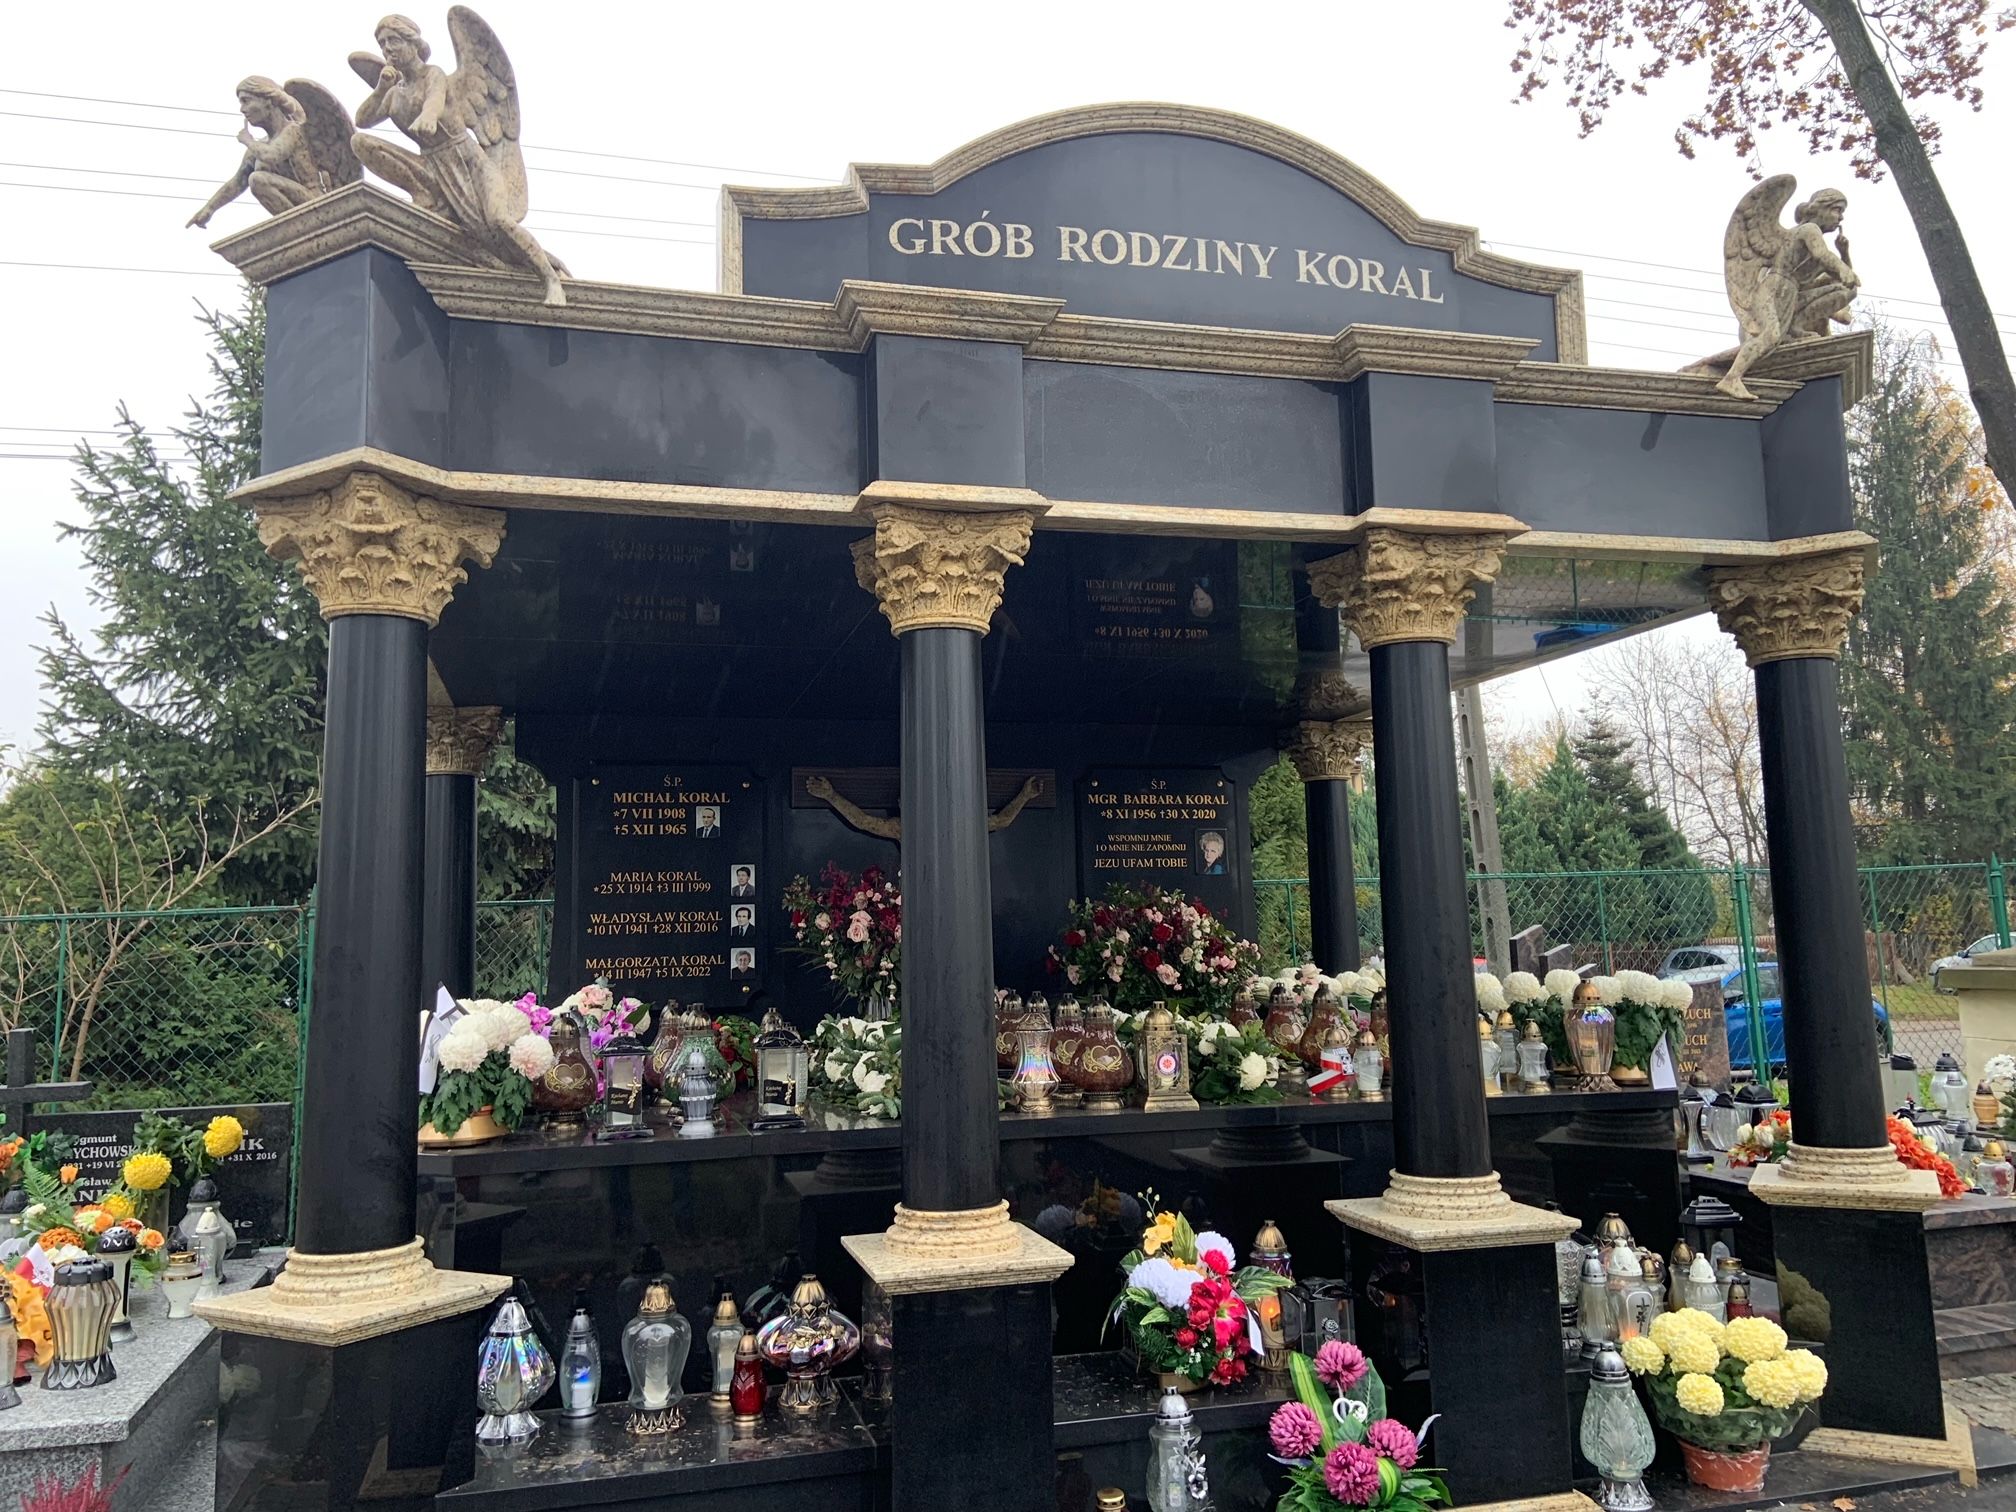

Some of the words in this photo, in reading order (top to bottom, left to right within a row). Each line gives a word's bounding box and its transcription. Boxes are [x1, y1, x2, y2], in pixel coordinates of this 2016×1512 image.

[889, 210, 1034, 258] GRÓB
[1057, 226, 1278, 279] RODZINY
[1295, 248, 1444, 304] KORAL
[679, 792, 731, 804] KORAL
[1088, 793, 1117, 805] MGR
[1124, 793, 1183, 805] BARBARA
[1186, 793, 1229, 805] KORAL
[632, 808, 653, 819] VII
[658, 808, 686, 819] 1908
[1116, 808, 1129, 819] XI
[1133, 808, 1157, 819] 1956
[1181, 808, 1190, 819] X
[1192, 808, 1217, 819] 2020
[633, 824, 654, 836] XII
[659, 823, 687, 835] 1965
[1107, 834, 1149, 843] WSPOMNIJ
[1151, 834, 1172, 842] MNIE
[1108, 844, 1130, 852] MNIE
[1146, 843, 1187, 851] ZAPOMNIJ
[1094, 858, 1120, 868] JEZU
[1122, 858, 1153, 868] UFAM
[1155, 858, 1188, 868] TOBIE
[610, 872, 654, 883] MARIA
[657, 871, 702, 882] KORAL
[616, 883, 625, 894] X
[629, 883, 652, 894] 1914
[672, 882, 684, 893] III
[688, 882, 711, 893] 1999
[590, 911, 676, 924] WŁADYSŁAW
[679, 911, 723, 922] KORAL
[608, 924, 622, 935] IV
[625, 924, 648, 935] 1941
[674, 923, 691, 934] XII
[694, 922, 719, 933] 2016
[585, 956, 678, 969] MAŁGORZATA
[681, 954, 726, 966] KORAL
[615, 969, 624, 979] II
[628, 968, 651, 979] 1947
[671, 967, 684, 978] IX
[687, 966, 711, 977] 2022
[256, 1152, 277, 1160] 2016
[105, 1160, 114, 1168] VI
